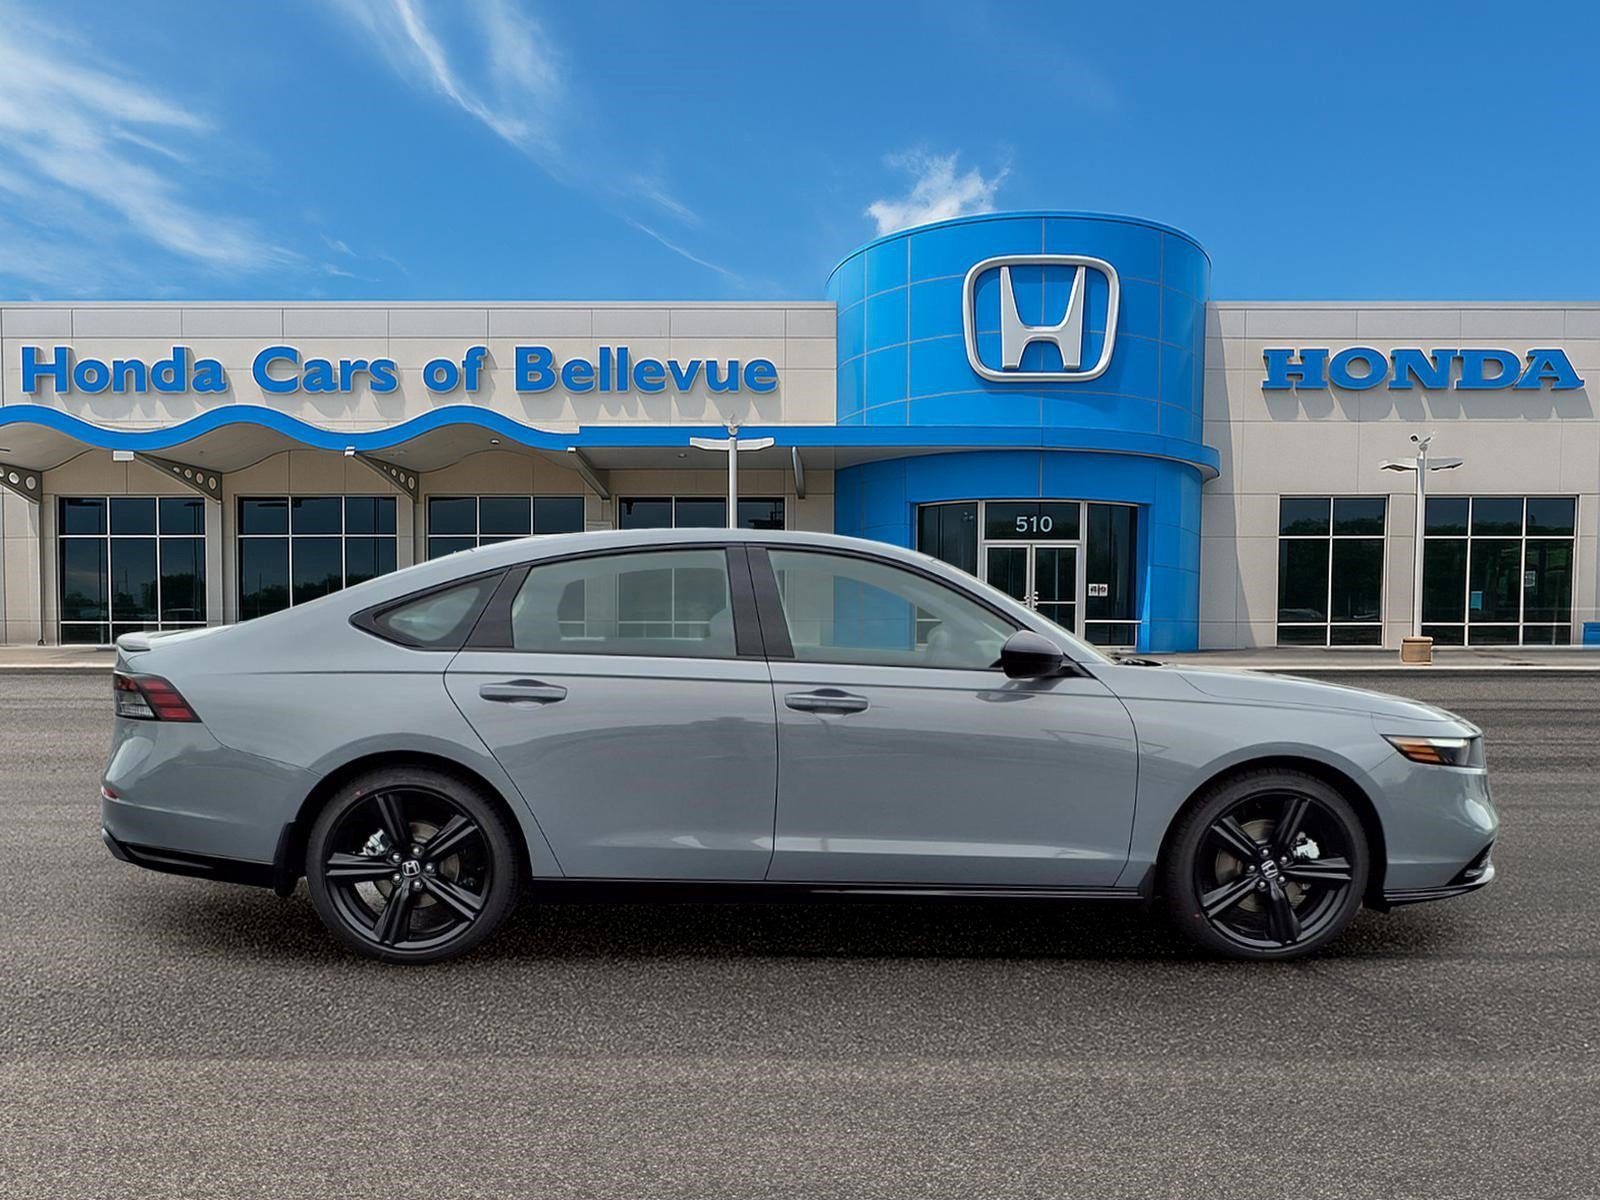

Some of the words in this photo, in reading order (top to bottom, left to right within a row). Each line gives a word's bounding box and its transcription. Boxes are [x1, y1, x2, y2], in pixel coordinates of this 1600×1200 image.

[21, 345, 228, 394] Honda
[252, 345, 399, 394] Cars
[422, 345, 488, 394] of
[514, 345, 779, 394] Bellevue
[1261, 347, 1585, 391] HONDA
[1015, 515, 1053, 533] 510
